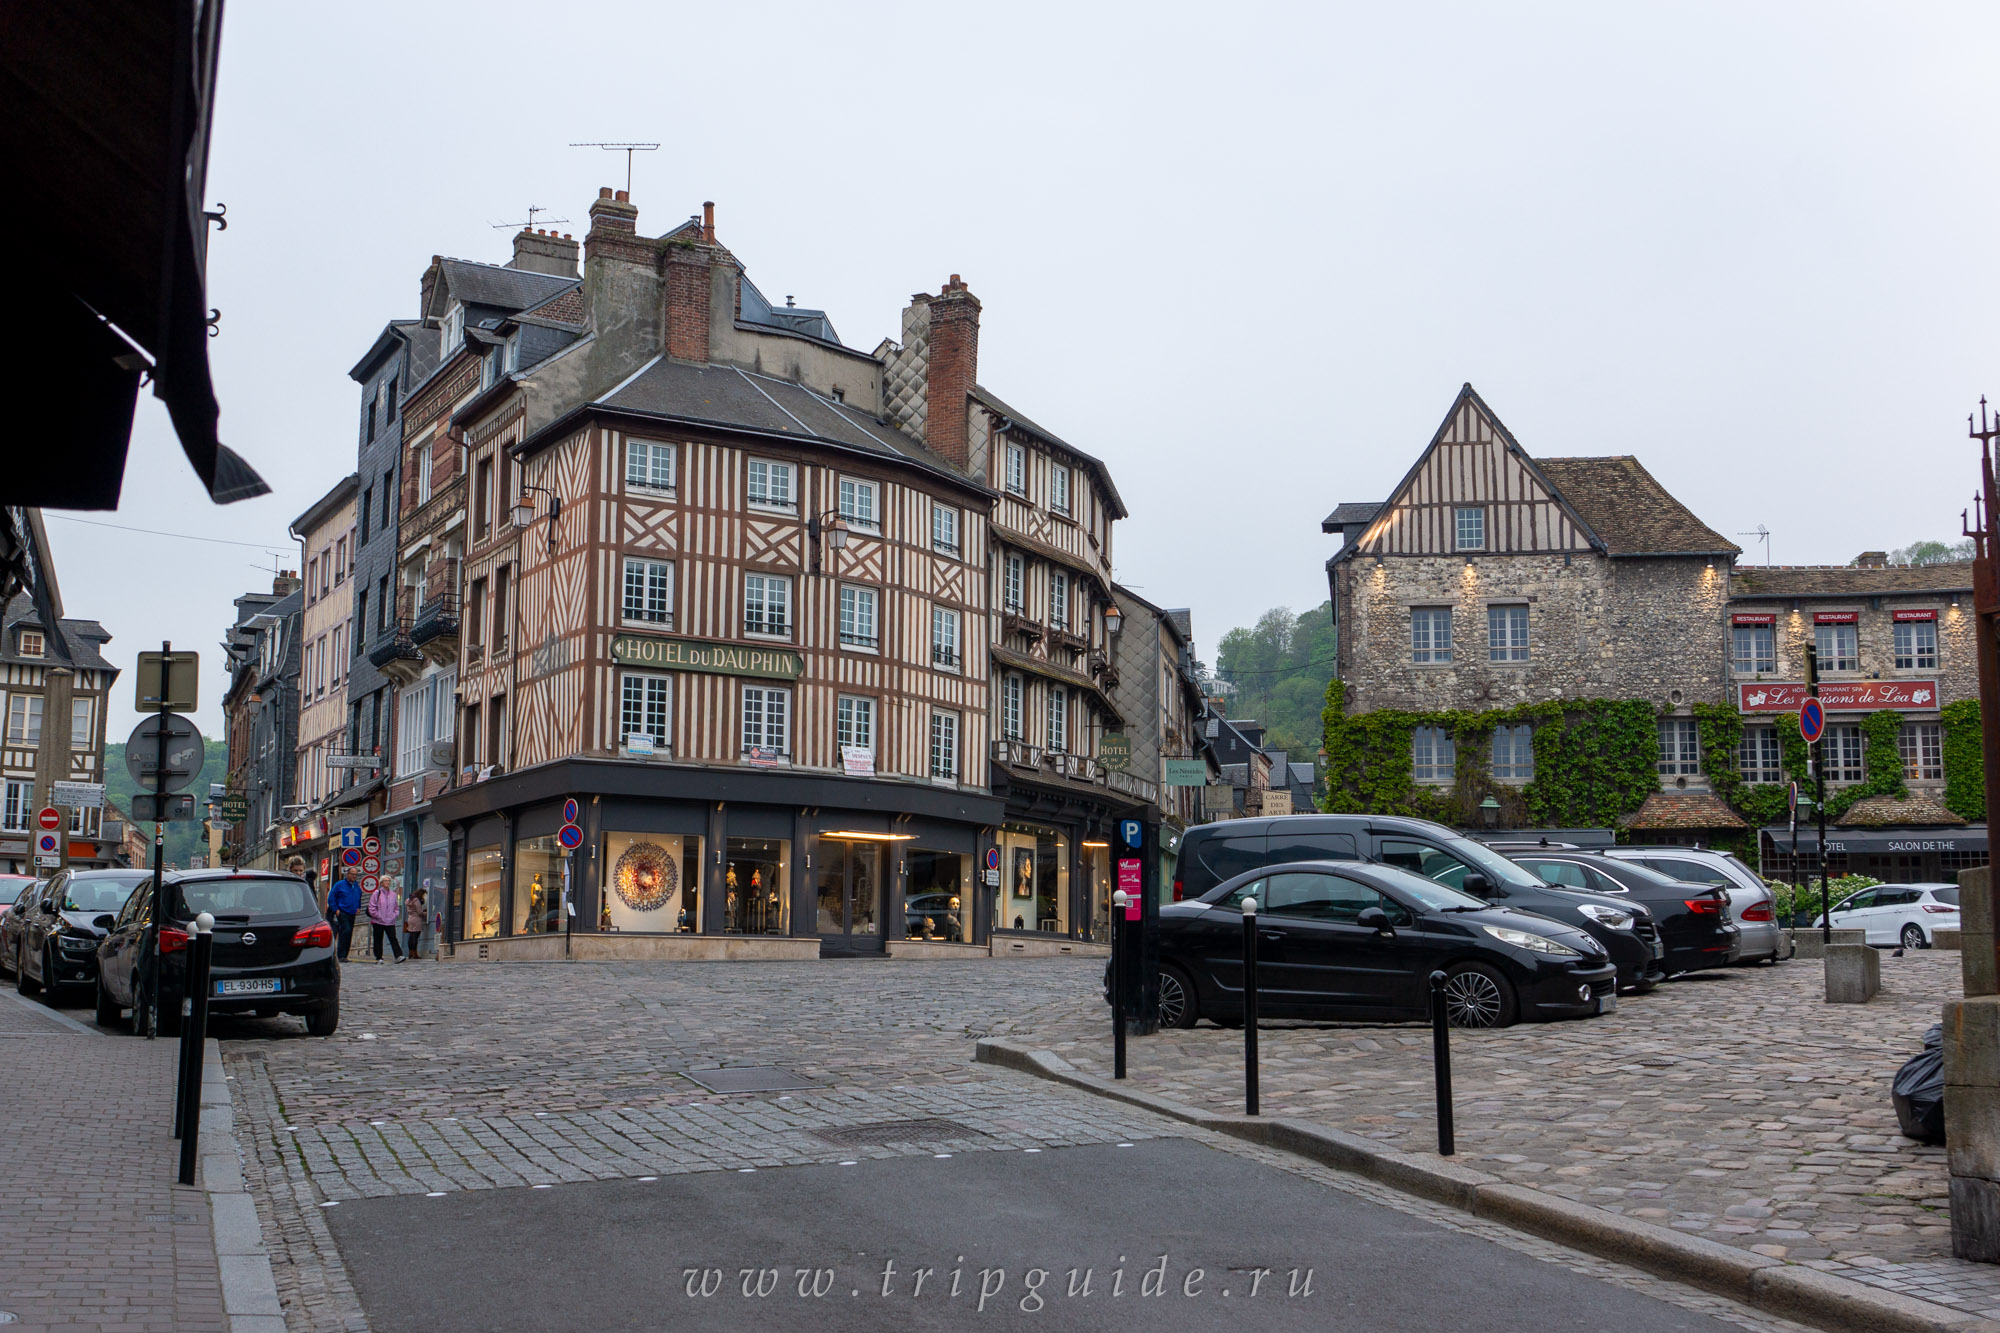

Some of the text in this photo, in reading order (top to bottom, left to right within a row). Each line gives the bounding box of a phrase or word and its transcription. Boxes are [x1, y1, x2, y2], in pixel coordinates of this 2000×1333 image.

[626, 640, 793, 673] HOTEL DU DAUPHIN
[1768, 687, 1795, 705] Les
[1858, 689, 1875, 704] de
[1878, 685, 1910, 704] Léa
[1100, 745, 1129, 755] HOTEL
[1101, 757, 1129, 770] DAUPHIN
[222, 801, 247, 809] HOTEL
[1126, 822, 1139, 844] P
[1888, 841, 1921, 851] SALON
[1922, 841, 1935, 850] DE
[1937, 841, 1955, 850] THE
[224, 980, 274, 991] EL-930-HS
